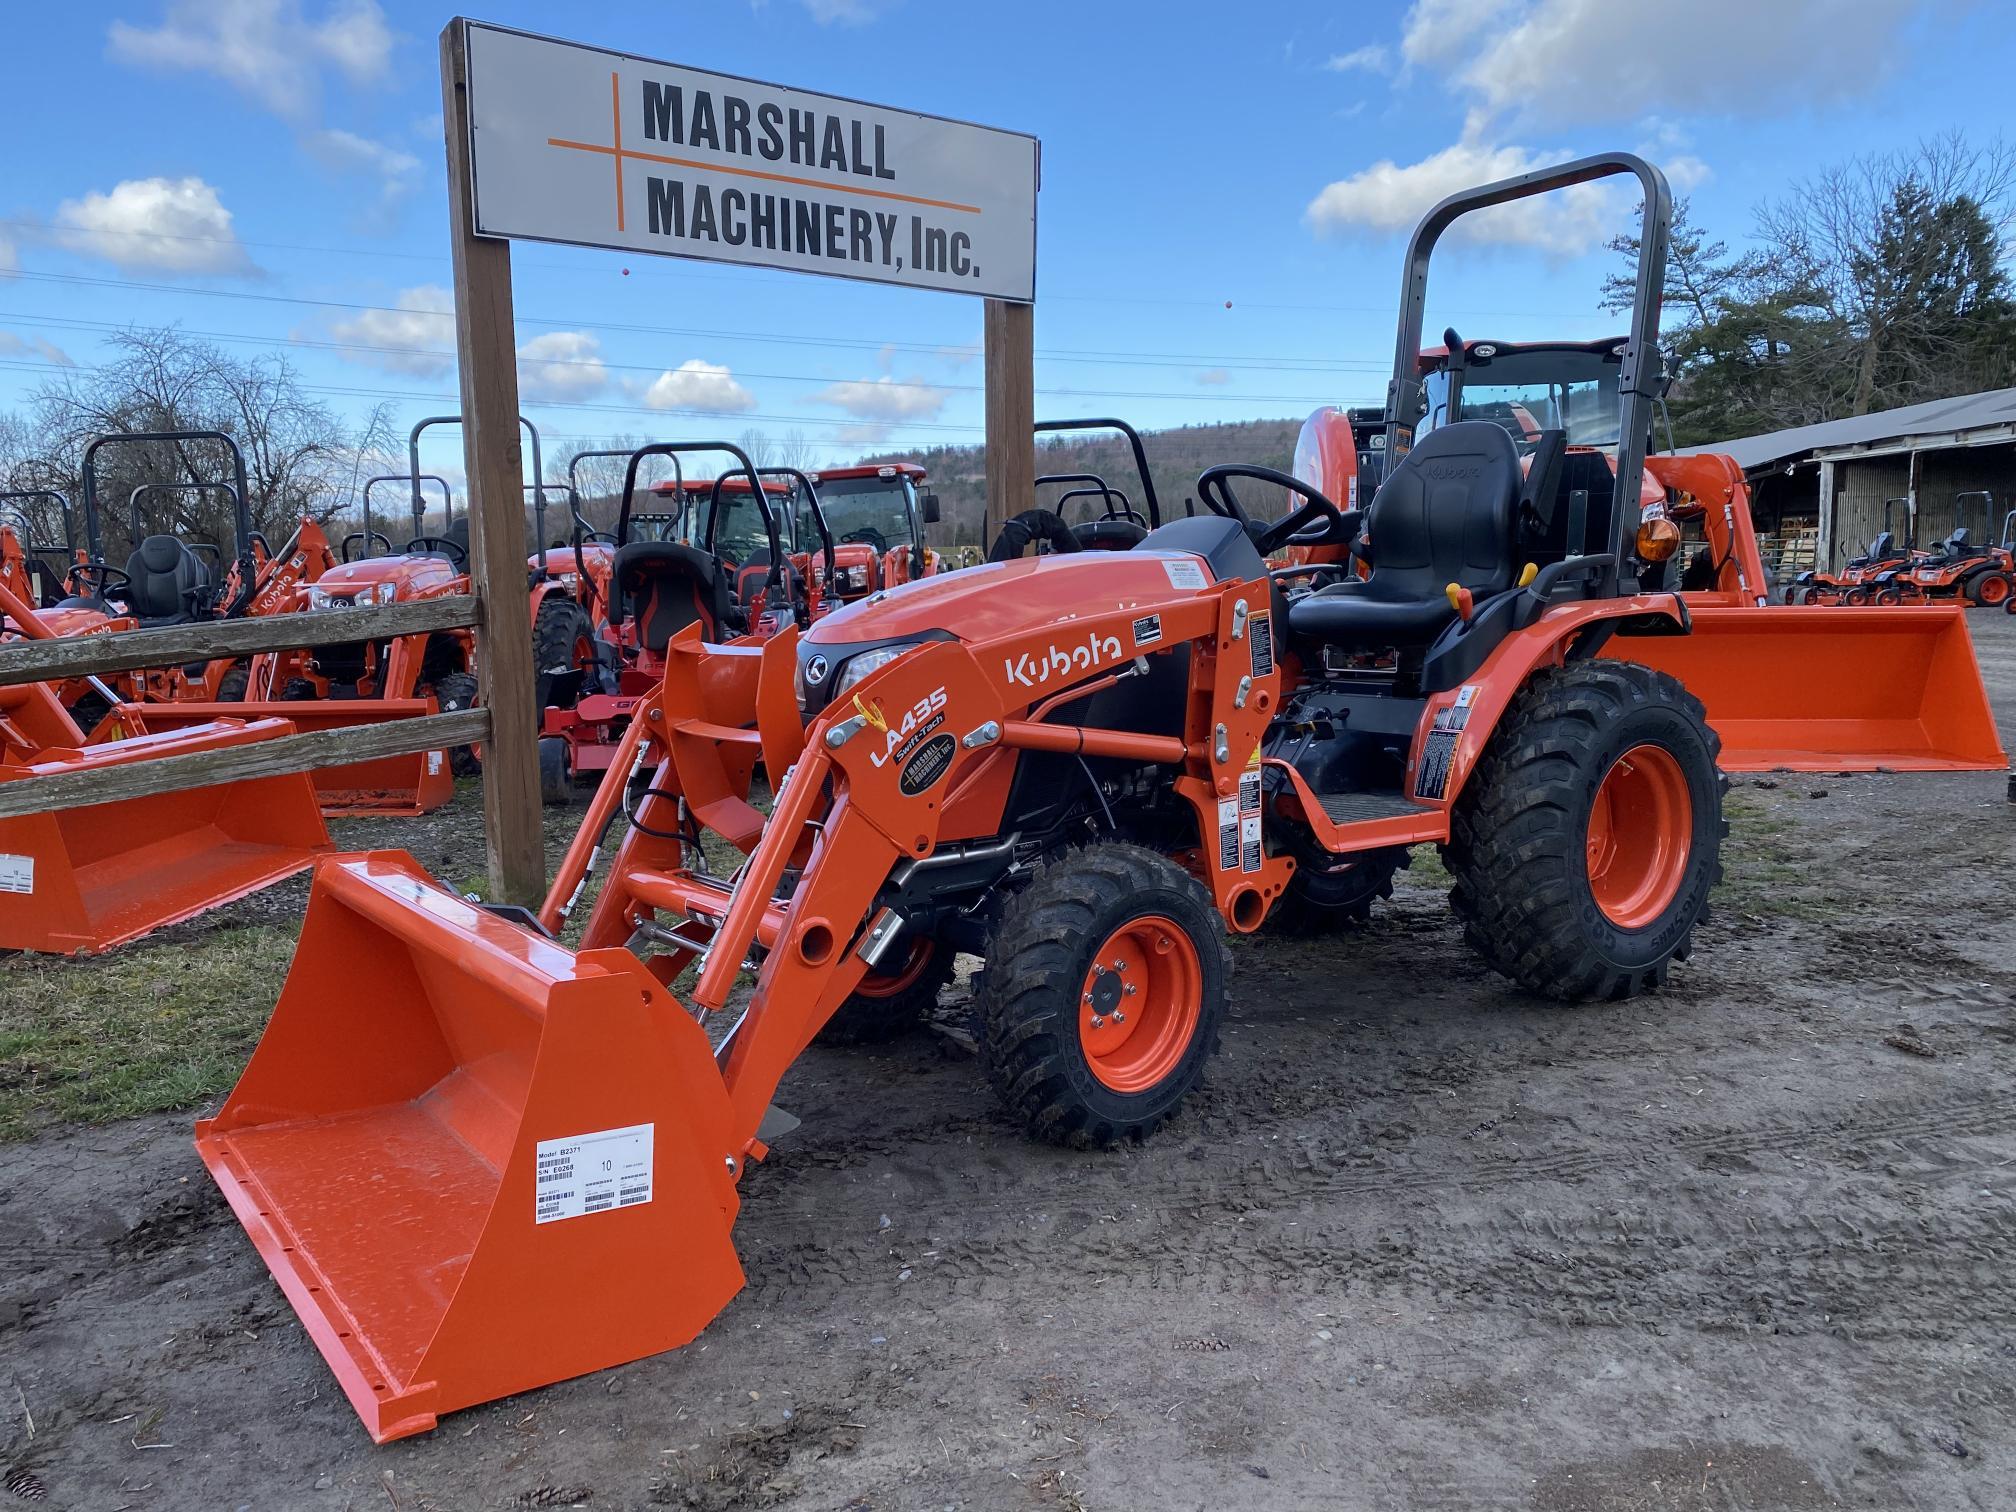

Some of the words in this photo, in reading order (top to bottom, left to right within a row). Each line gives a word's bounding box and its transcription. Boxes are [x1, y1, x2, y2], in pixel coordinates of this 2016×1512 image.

[642, 80, 896, 181] MARSHALL
[647, 176, 904, 273] MACHINERY,
[910, 215, 981, 278] Inc.
[261, 575, 292, 609] Kubota
[1005, 632, 1123, 687] Kubota
[869, 685, 948, 768] LA435
[896, 714, 944, 762] Swift-Tach
[907, 743, 939, 776] MARSHALL
[553, 1164, 574, 1174] E0268
[560, 1146, 581, 1156] B2371
[601, 1159, 612, 1172] 10
